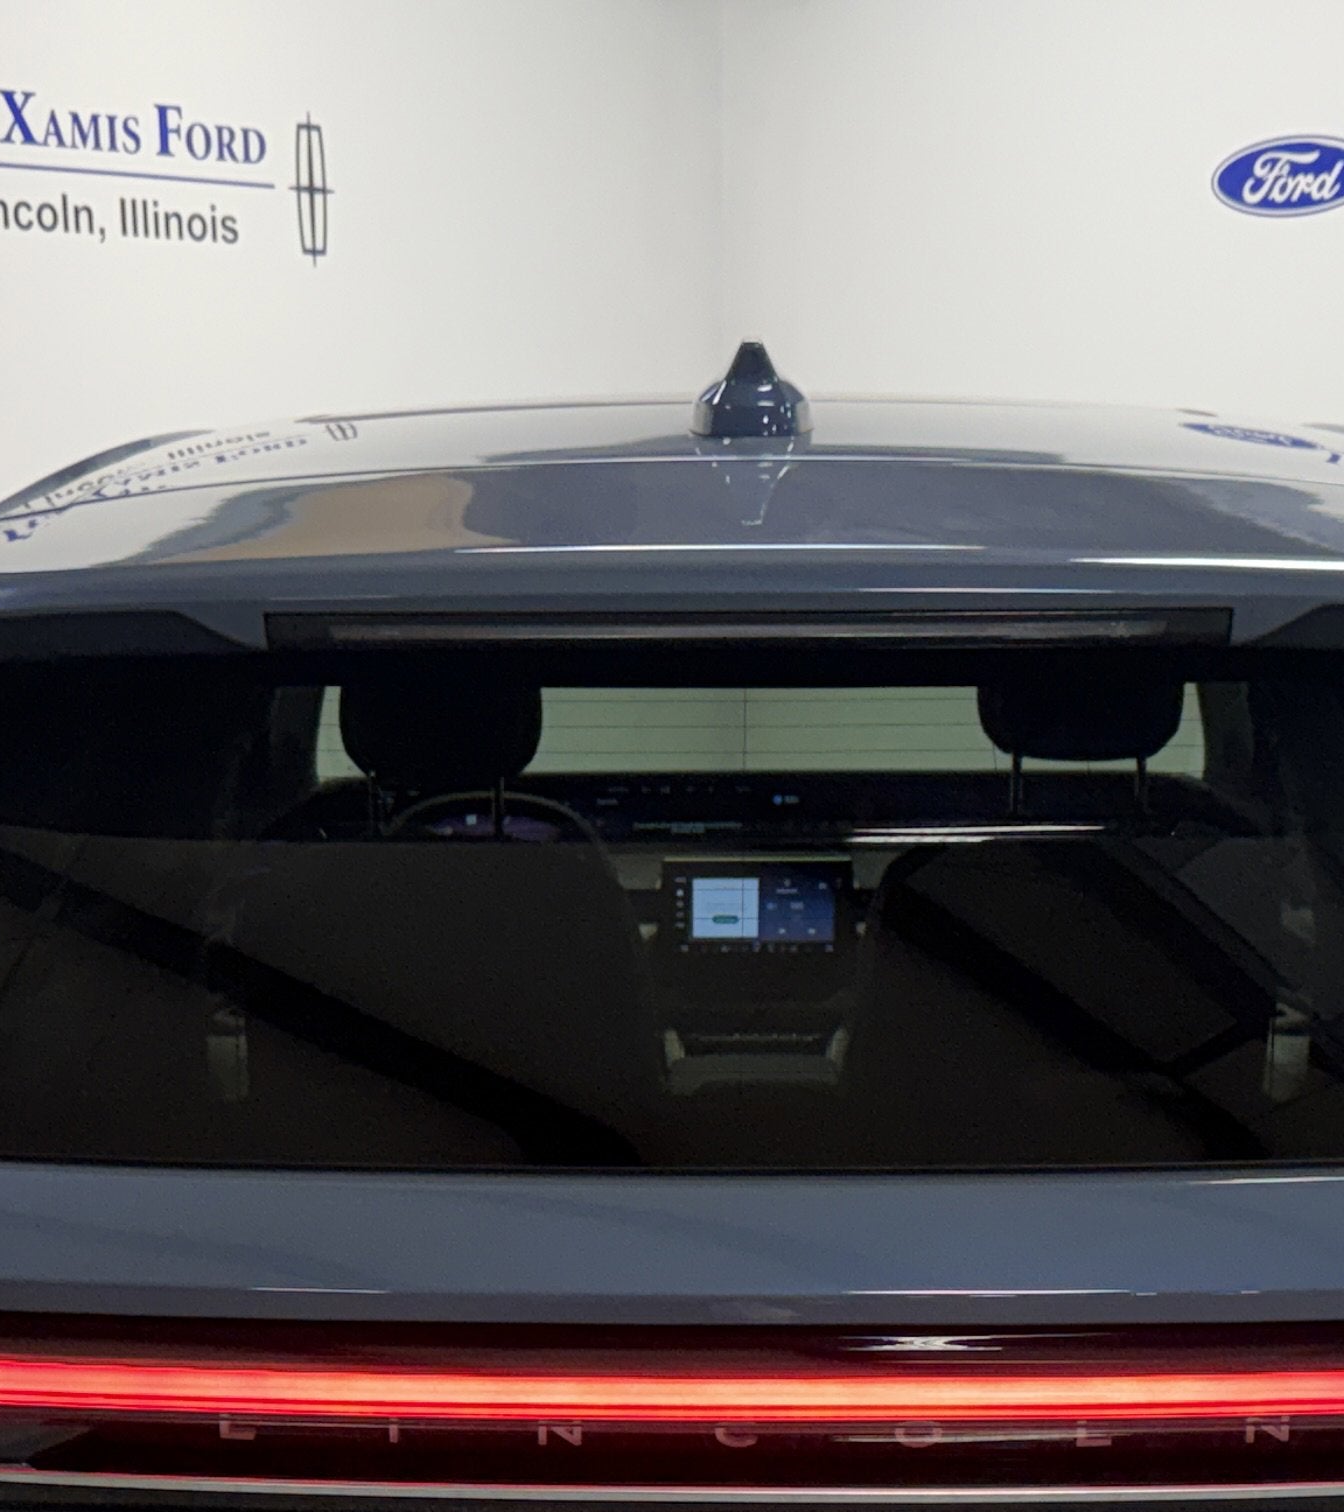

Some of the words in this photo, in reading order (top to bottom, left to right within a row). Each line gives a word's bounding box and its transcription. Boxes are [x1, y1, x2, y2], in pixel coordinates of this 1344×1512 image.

[153, 103, 267, 164] FORD
[1241, 150, 1344, 205] Ford
[119, 197, 239, 245] Illinois
[219, 1413, 1290, 1448] LINCOLN
